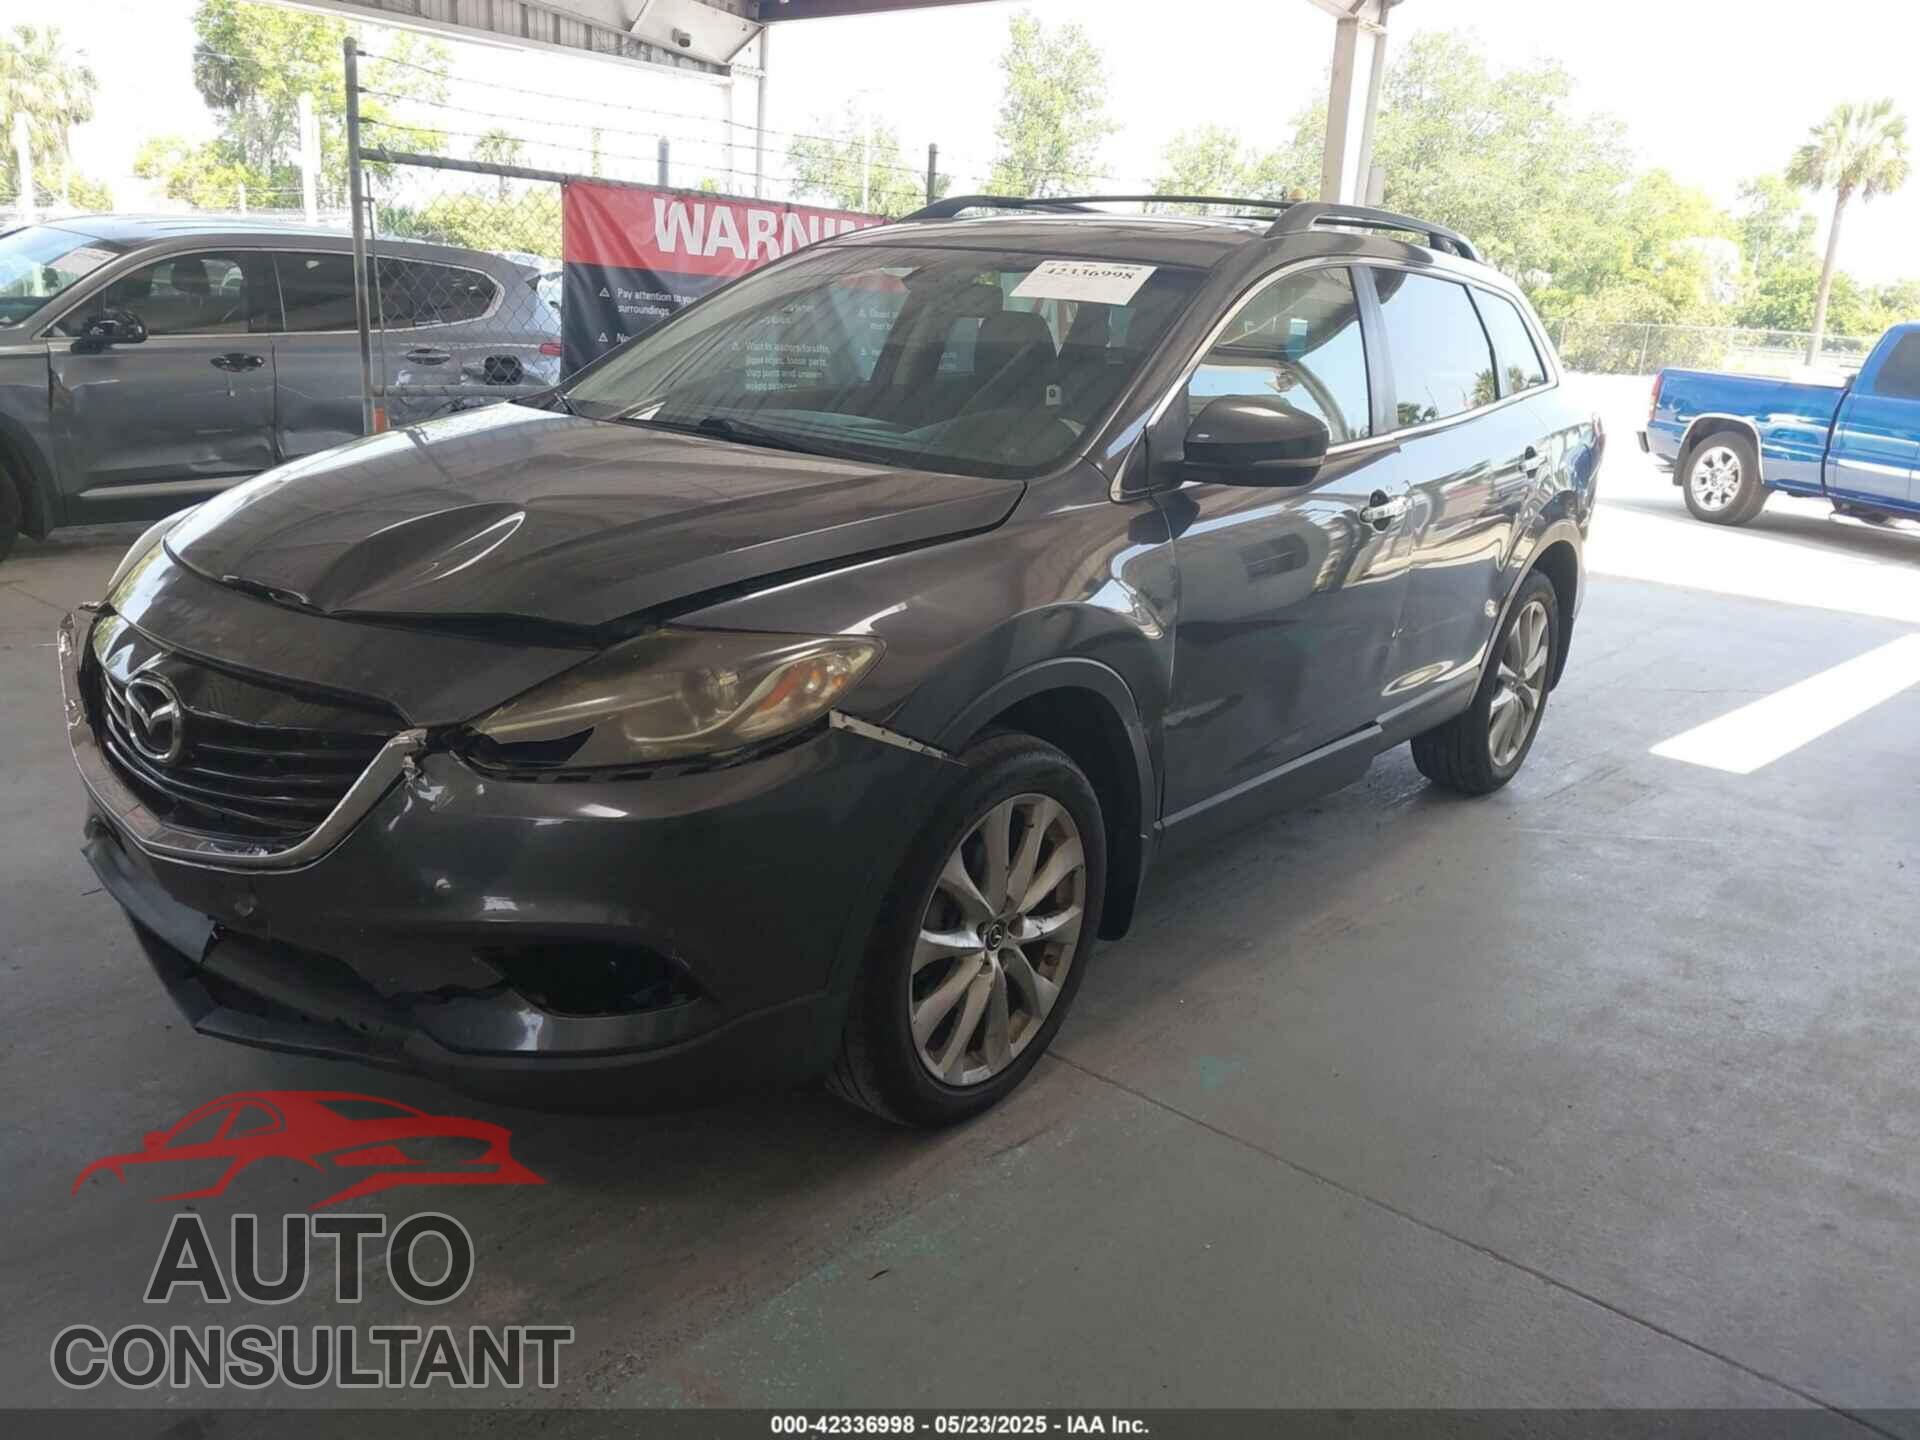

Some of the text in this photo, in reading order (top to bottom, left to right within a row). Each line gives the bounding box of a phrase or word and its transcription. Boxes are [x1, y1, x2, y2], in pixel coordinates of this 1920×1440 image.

[653, 197, 878, 262] WARNI
[616, 287, 632, 301] Pay
[634, 290, 672, 302] attention
[616, 304, 670, 317] surroundings
